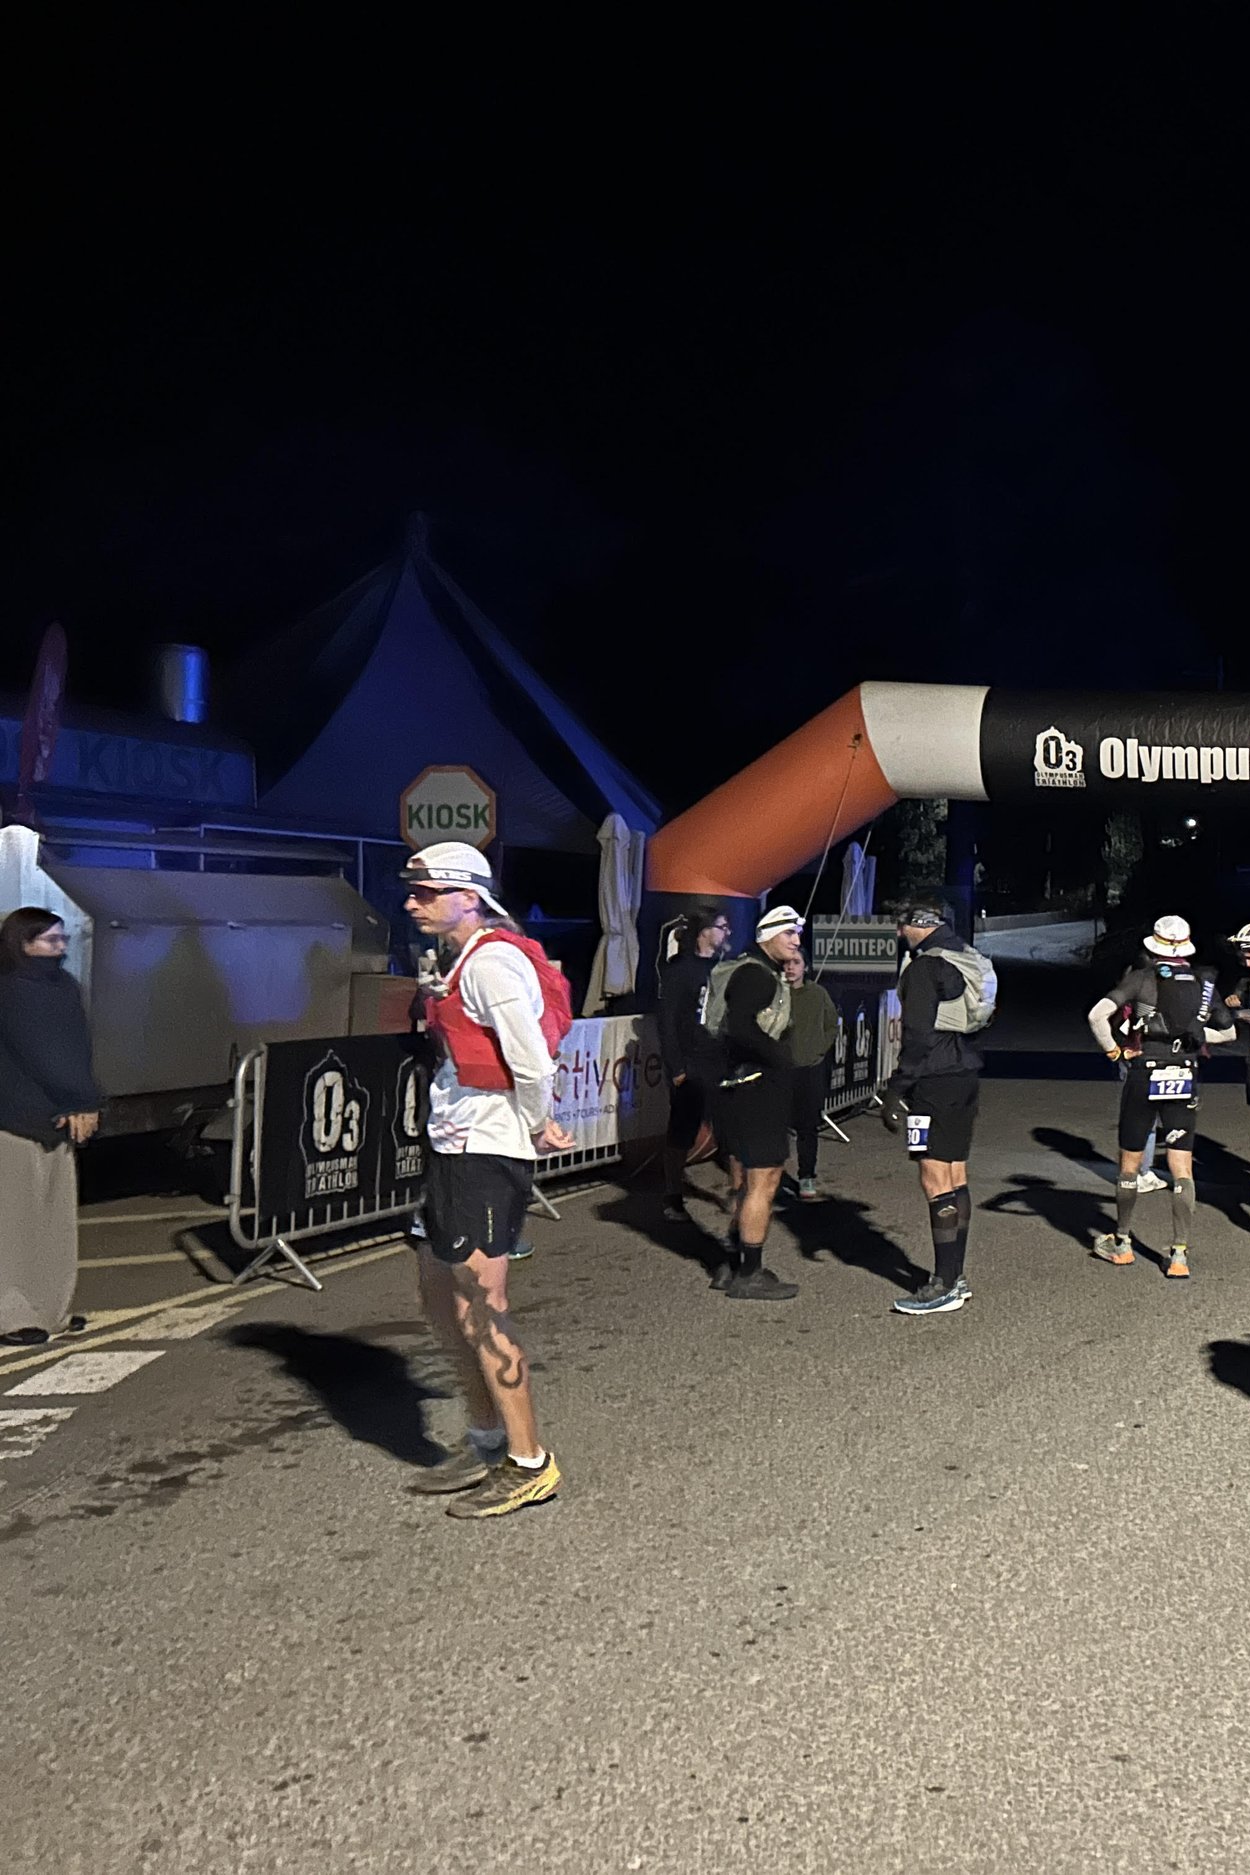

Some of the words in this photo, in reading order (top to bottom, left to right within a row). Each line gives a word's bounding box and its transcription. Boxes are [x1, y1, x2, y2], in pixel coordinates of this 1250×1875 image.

[79, 736, 227, 797] KIOSK
[1036, 778, 1085, 786] TRIATHLON
[408, 804, 489, 829] KIOSK
[815, 938, 896, 956] ΠΕΡΙΠΤΕΡΟ
[552, 1043, 662, 1103] ctivate
[1157, 1080, 1185, 1094] 127
